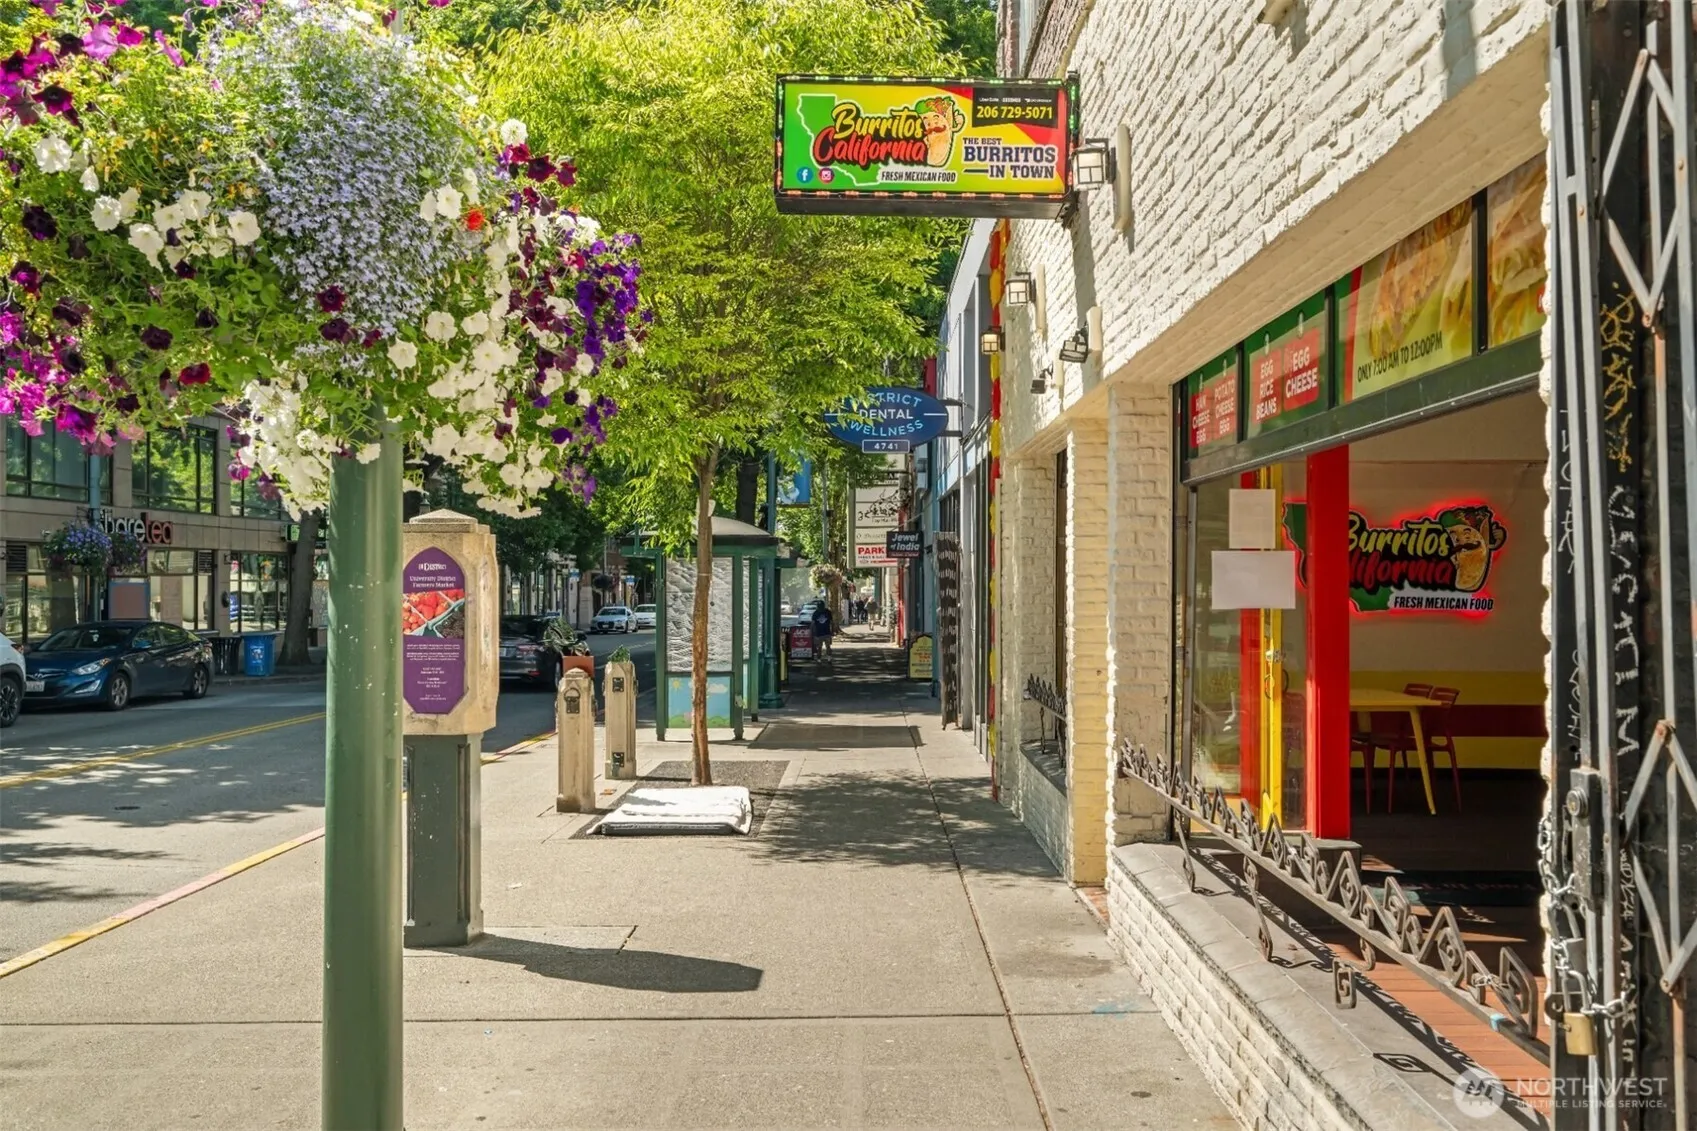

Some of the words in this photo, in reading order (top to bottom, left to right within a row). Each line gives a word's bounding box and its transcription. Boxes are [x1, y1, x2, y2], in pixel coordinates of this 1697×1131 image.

[976, 105, 998, 118] 206
[1001, 105, 1053, 119] 729-5071
[831, 103, 922, 139] Burritos
[813, 127, 927, 166] California
[963, 146, 1056, 163] BURRITOS
[881, 171, 904, 181] FRESH
[904, 171, 937, 182] MEXICAN
[938, 172, 956, 183] FOOD
[989, 164, 1005, 177] IN
[1010, 165, 1055, 179] TOWN
[1292, 347, 1311, 373] EGG
[1357, 363, 1373, 382] ONLY
[1373, 355, 1387, 376] 7:00
[1400, 346, 1409, 364] TO
[1260, 359, 1274, 379] EGG
[1259, 378, 1274, 399] RICE
[1285, 367, 1318, 398] CHEESE
[859, 408, 914, 420] DENTAL
[1215, 397, 1234, 419] CHEESE
[1256, 397, 1277, 420] BEANS
[850, 420, 924, 437] WELLNESS
[1192, 410, 1210, 430] CHEESE
[1219, 418, 1230, 435] EGG
[874, 442, 899, 451] 4741
[891, 533, 920, 542] Jewel
[897, 542, 920, 551] India
[1394, 596, 1423, 609] FRESH
[1425, 596, 1468, 610] MEXICAN
[1470, 597, 1494, 611] FOOD
